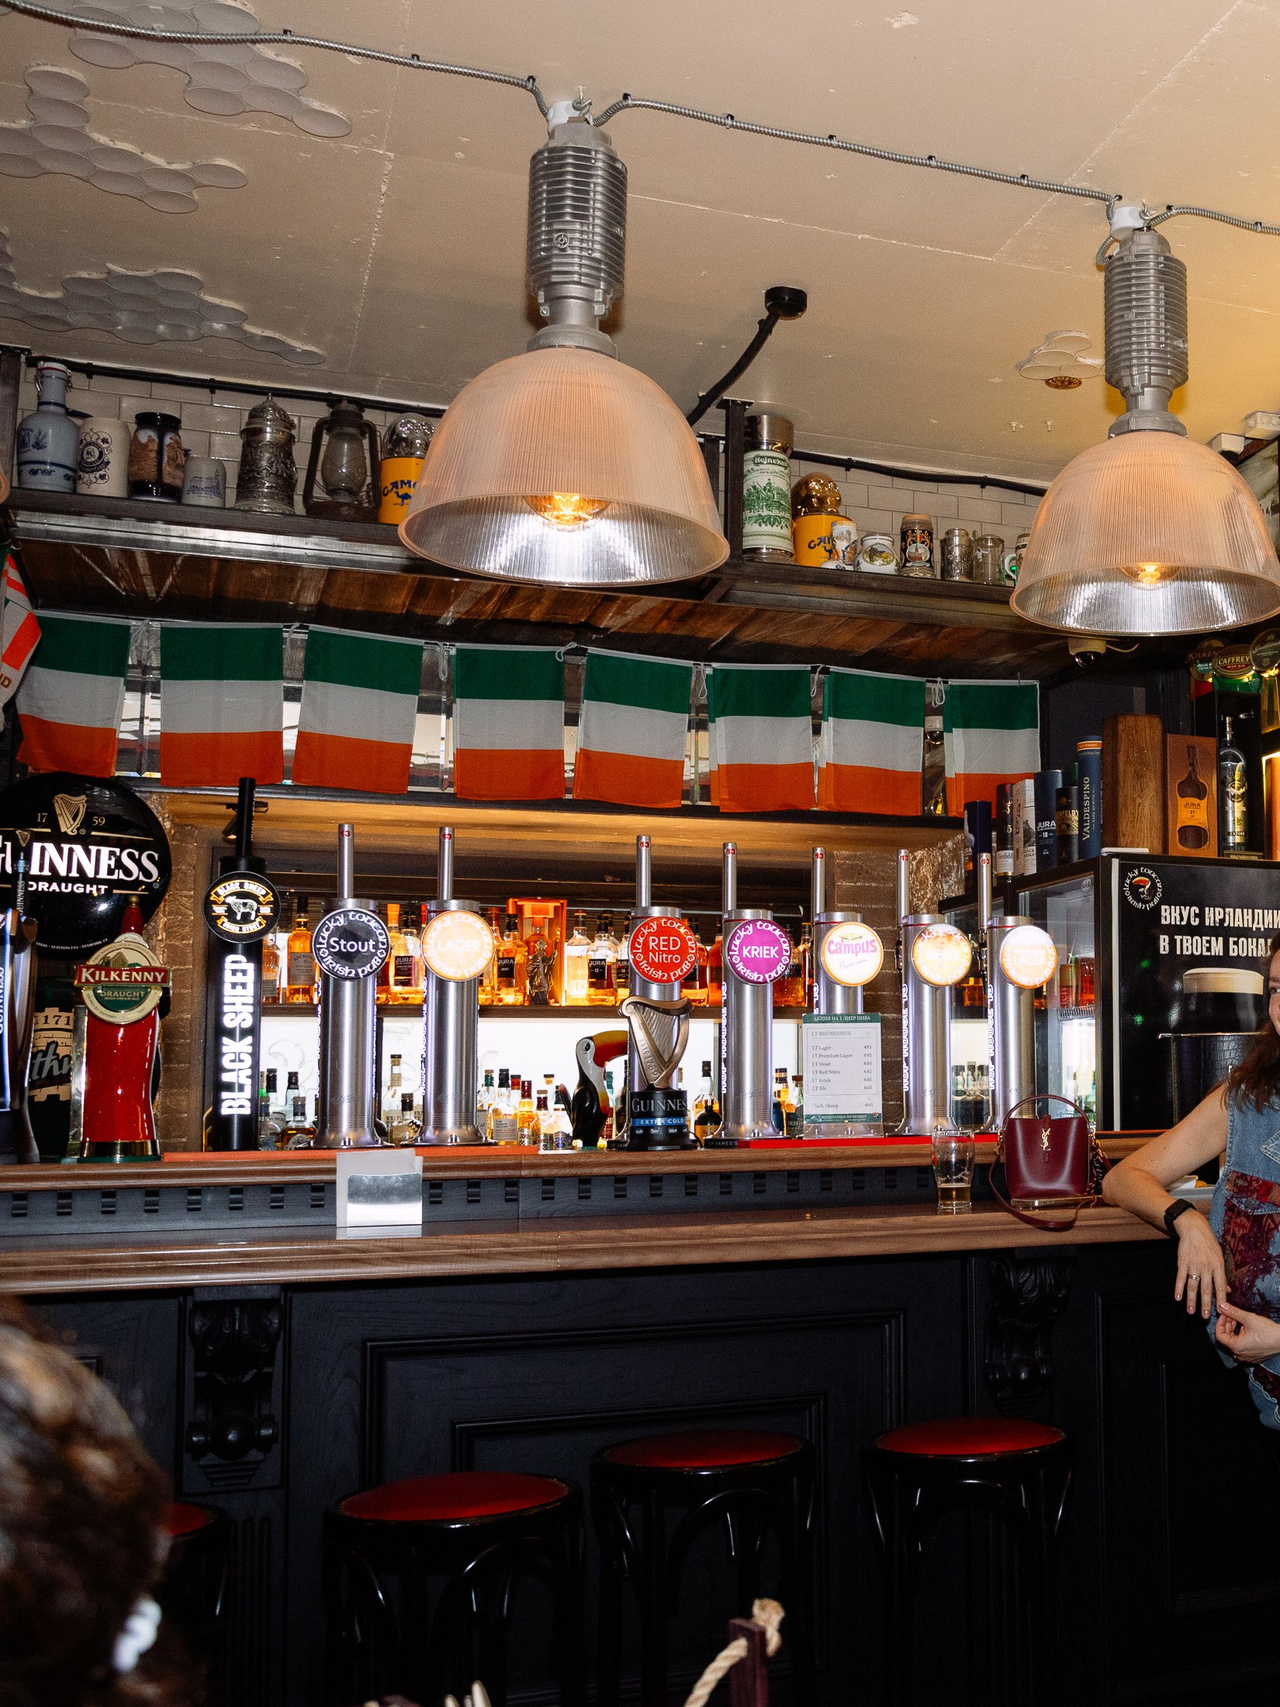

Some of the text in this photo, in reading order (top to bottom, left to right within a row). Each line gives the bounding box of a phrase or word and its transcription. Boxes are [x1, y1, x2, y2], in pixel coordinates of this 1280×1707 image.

[383, 480, 417, 497] CAM
[1218, 656, 1250, 665] CAFFREY
[1082, 776, 1090, 841] VALDESPINO
[37, 813, 106, 826] 17 59
[1036, 820, 1056, 828] JURA
[0, 834, 159, 882] UINNESS
[28, 882, 108, 894] DRAUGHT
[1160, 905, 1200, 926] ВКУС
[330, 937, 376, 952] Stout
[439, 940, 482, 952] LAGER
[649, 936, 681, 950] RED
[1160, 935, 1170, 954] В
[1174, 935, 1224, 956] ТВОЕМ
[649, 952, 681, 964] Nitro
[742, 946, 780, 958] KRIEK
[80, 968, 165, 982] KILKENNY
[223, 954, 254, 1028] SHEEP
[42, 1014, 72, 1025] 171
[221, 1036, 252, 1116] BLACK
